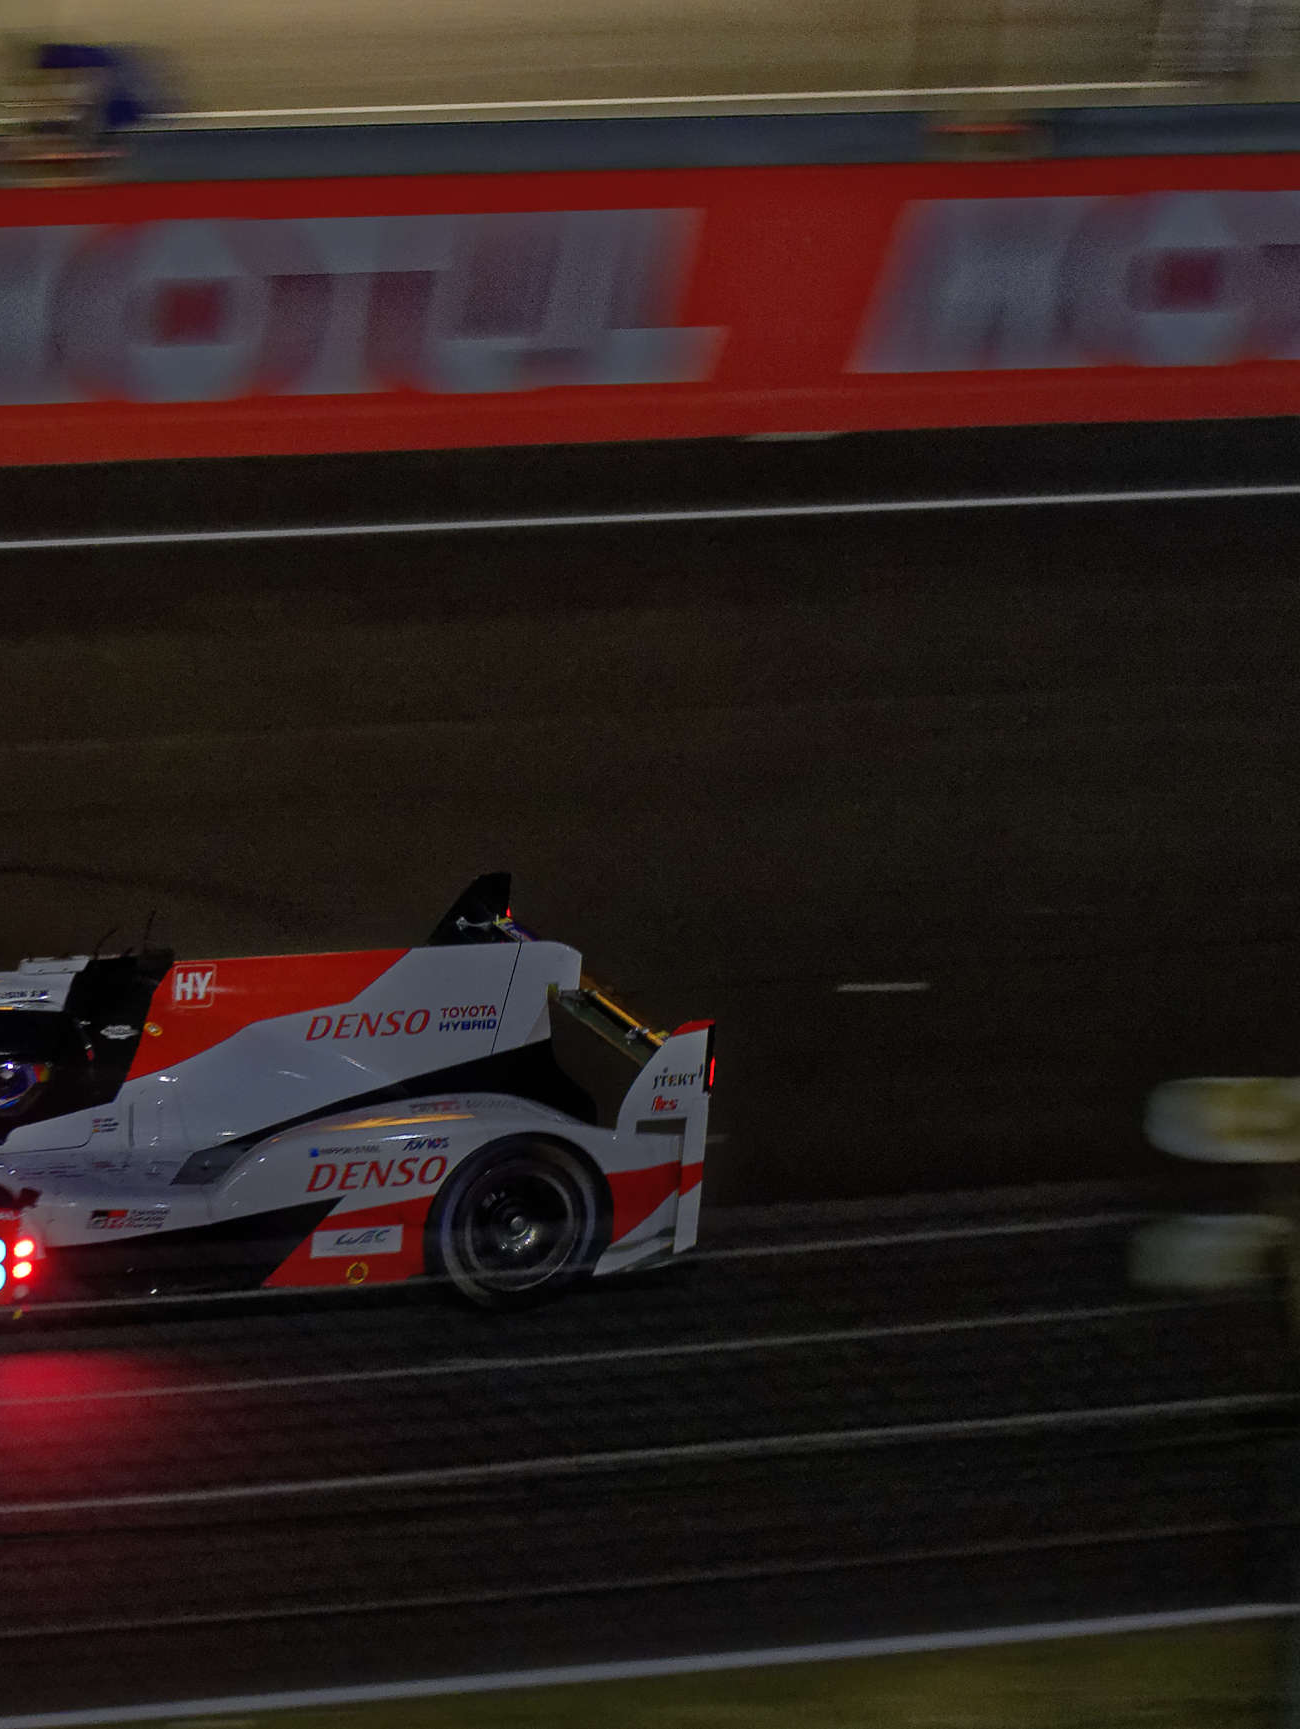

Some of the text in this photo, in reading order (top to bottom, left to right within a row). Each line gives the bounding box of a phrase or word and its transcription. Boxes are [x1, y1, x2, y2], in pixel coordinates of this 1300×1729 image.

[845, 190, 1300, 374] MO
[174, 971, 212, 1000] HY
[305, 1009, 431, 1042] DENSO
[439, 1018, 497, 1032] HYBRID
[440, 1005, 497, 1018] TOYOTA
[305, 1156, 448, 1192] DENSO
